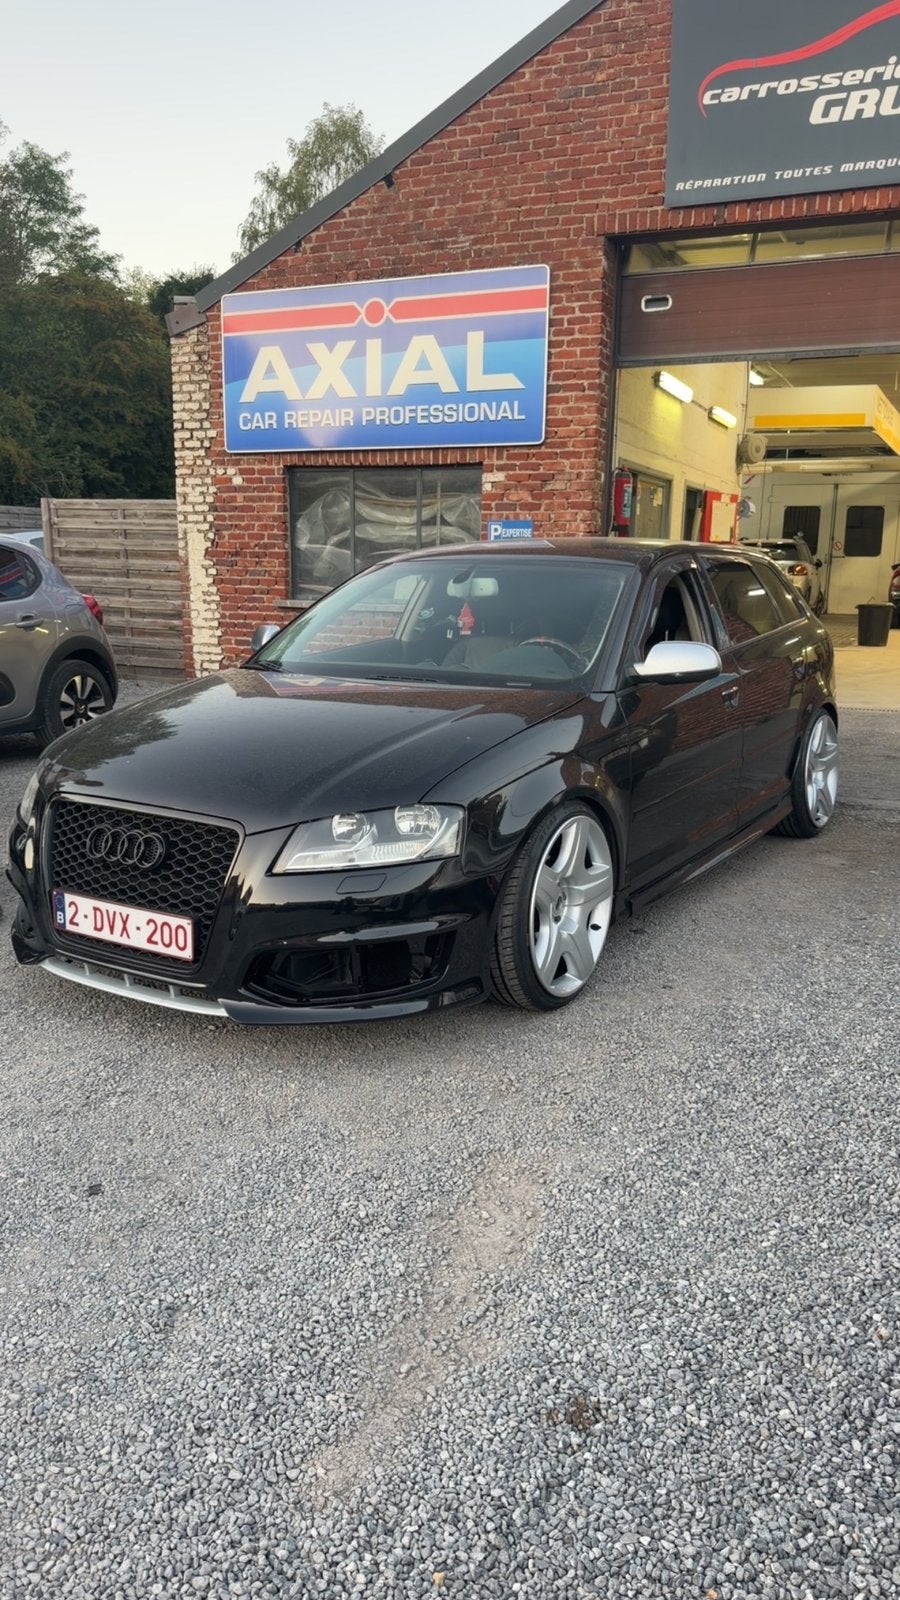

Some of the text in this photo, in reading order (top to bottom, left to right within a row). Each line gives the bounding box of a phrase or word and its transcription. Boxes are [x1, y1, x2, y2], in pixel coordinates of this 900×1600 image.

[675, 172, 767, 191] RÉPARATION
[774, 165, 833, 180] TOUTES
[239, 331, 525, 403] AXIAL
[239, 400, 526, 431] CAR REPAIR PROFESSIONAL
[490, 524, 532, 540] P EXPERTISE
[57, 911, 64, 923] B
